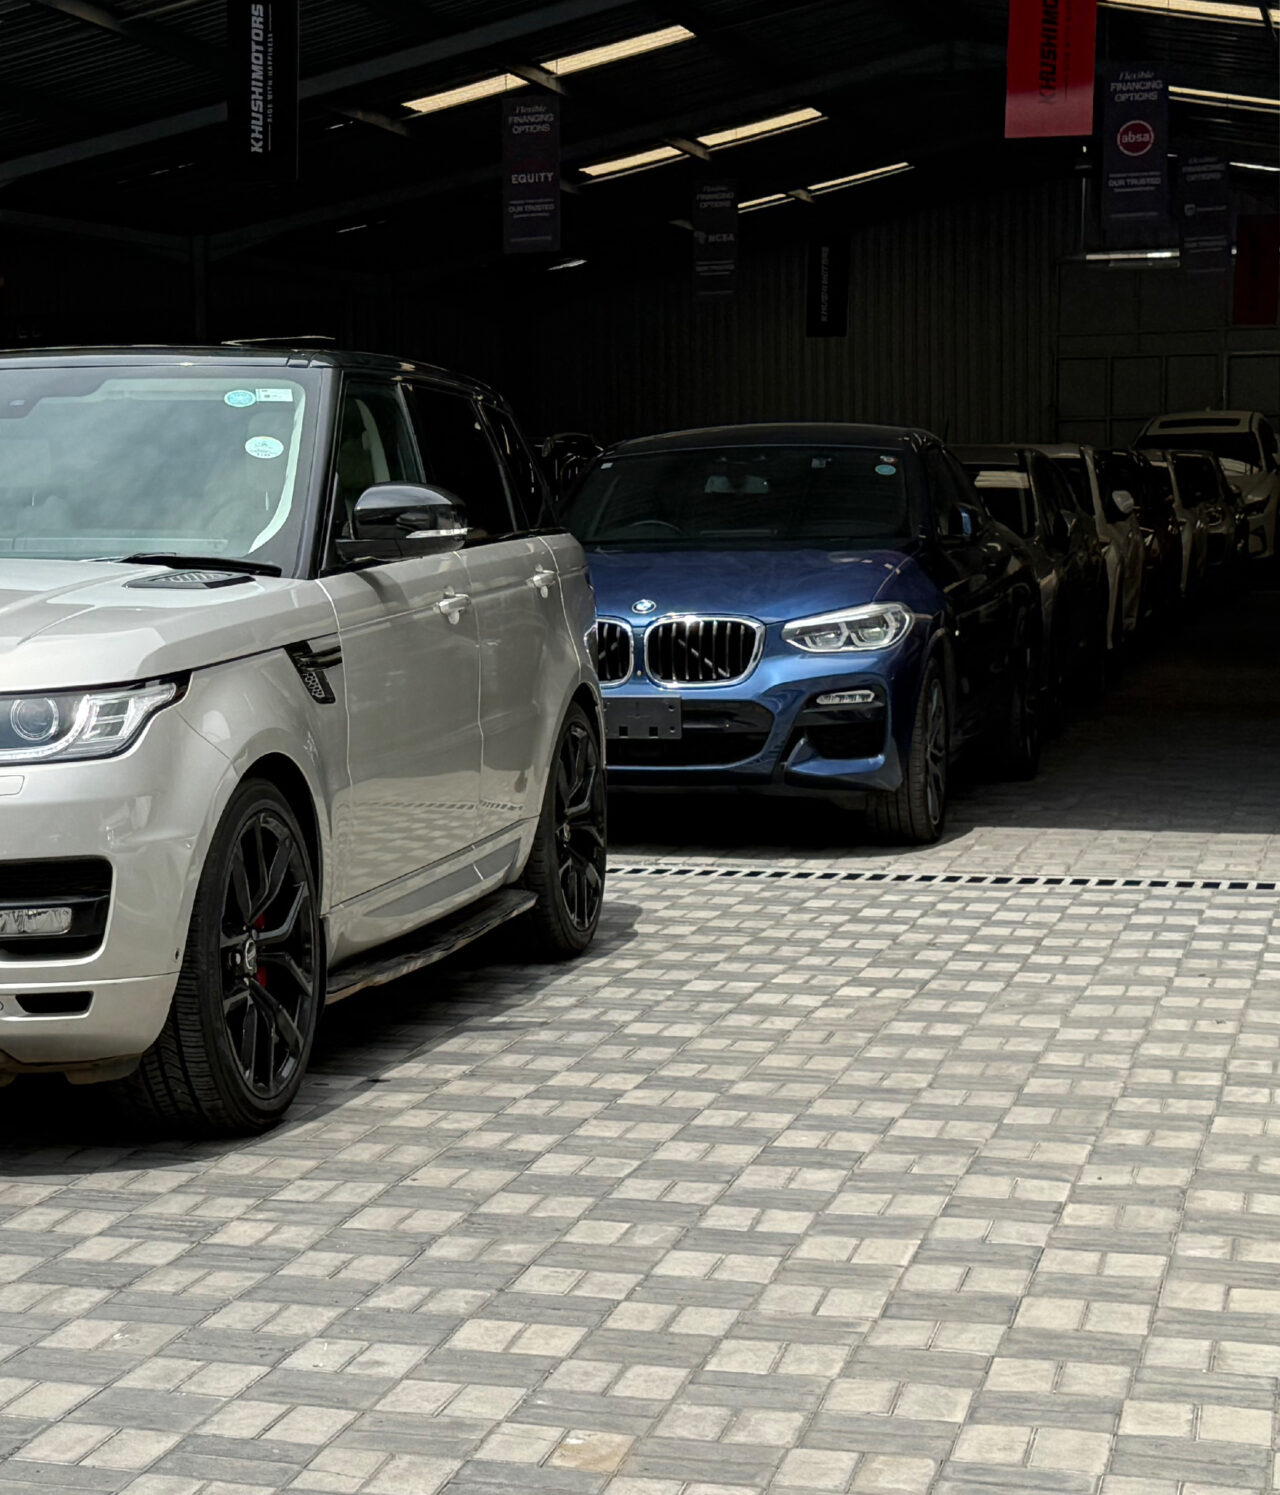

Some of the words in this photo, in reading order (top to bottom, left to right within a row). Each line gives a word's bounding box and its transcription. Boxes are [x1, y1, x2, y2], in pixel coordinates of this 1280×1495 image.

[250, 3, 264, 153] KHUSHIMOTORS
[1110, 80, 1163, 92] FINANCING
[1114, 91, 1159, 102] OPTIONS
[512, 124, 552, 134] OPTIONS
[1121, 130, 1150, 144] absa
[511, 172, 555, 184] EQUITY
[1126, 176, 1161, 186] TRUSTED
